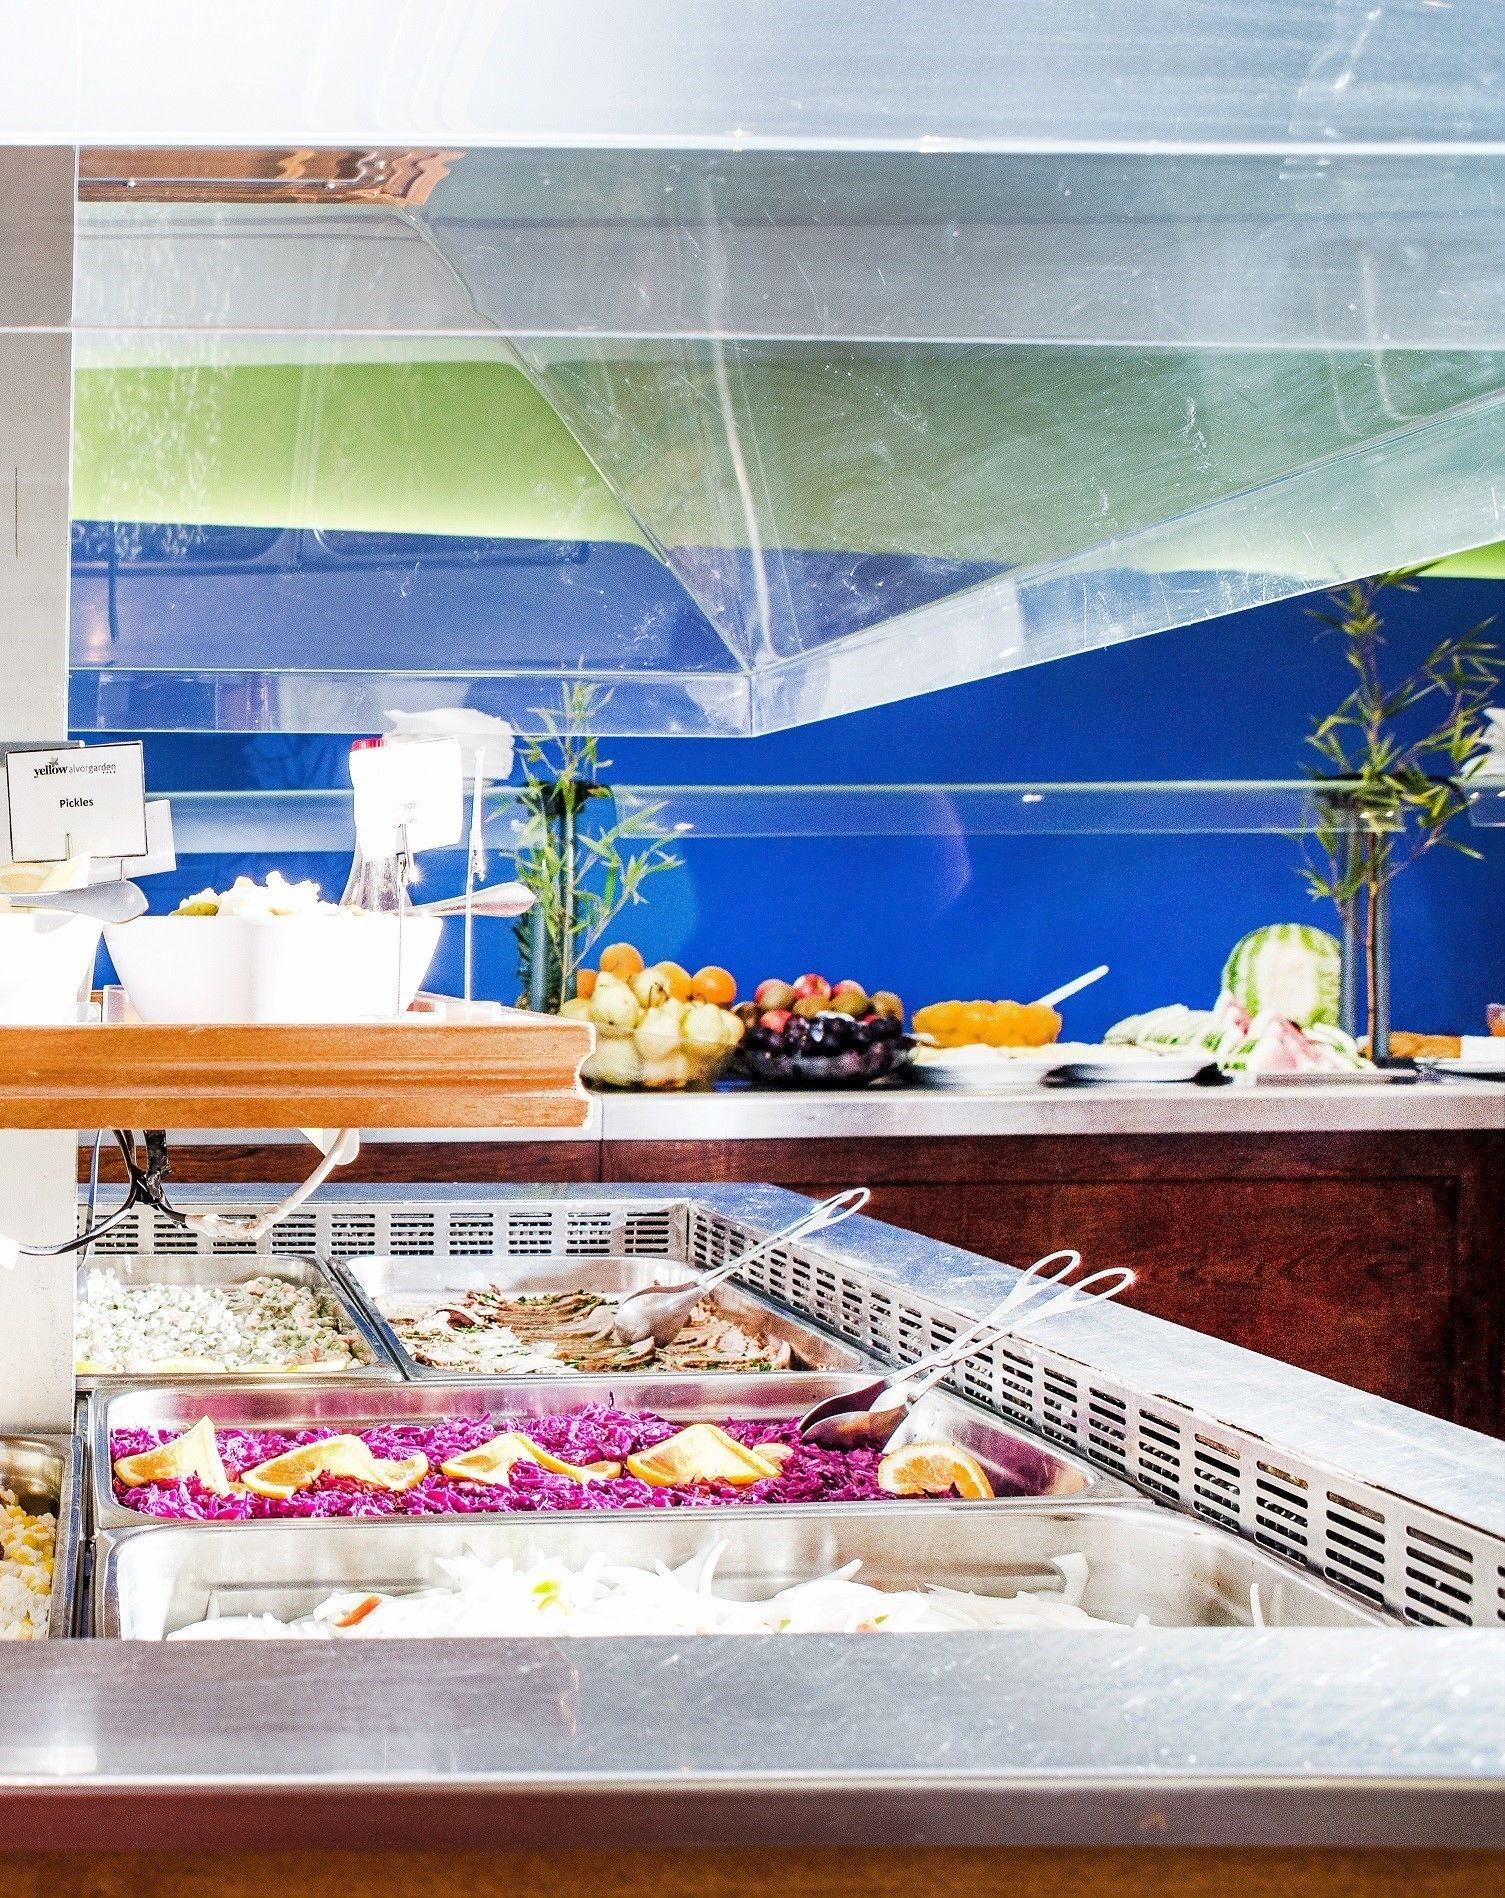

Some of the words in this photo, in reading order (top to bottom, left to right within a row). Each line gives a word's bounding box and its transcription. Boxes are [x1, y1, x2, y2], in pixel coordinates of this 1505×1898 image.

[33, 764, 68, 778] yellow
[68, 762, 117, 775] alvorgarden
[59, 797, 94, 808] Pickles
